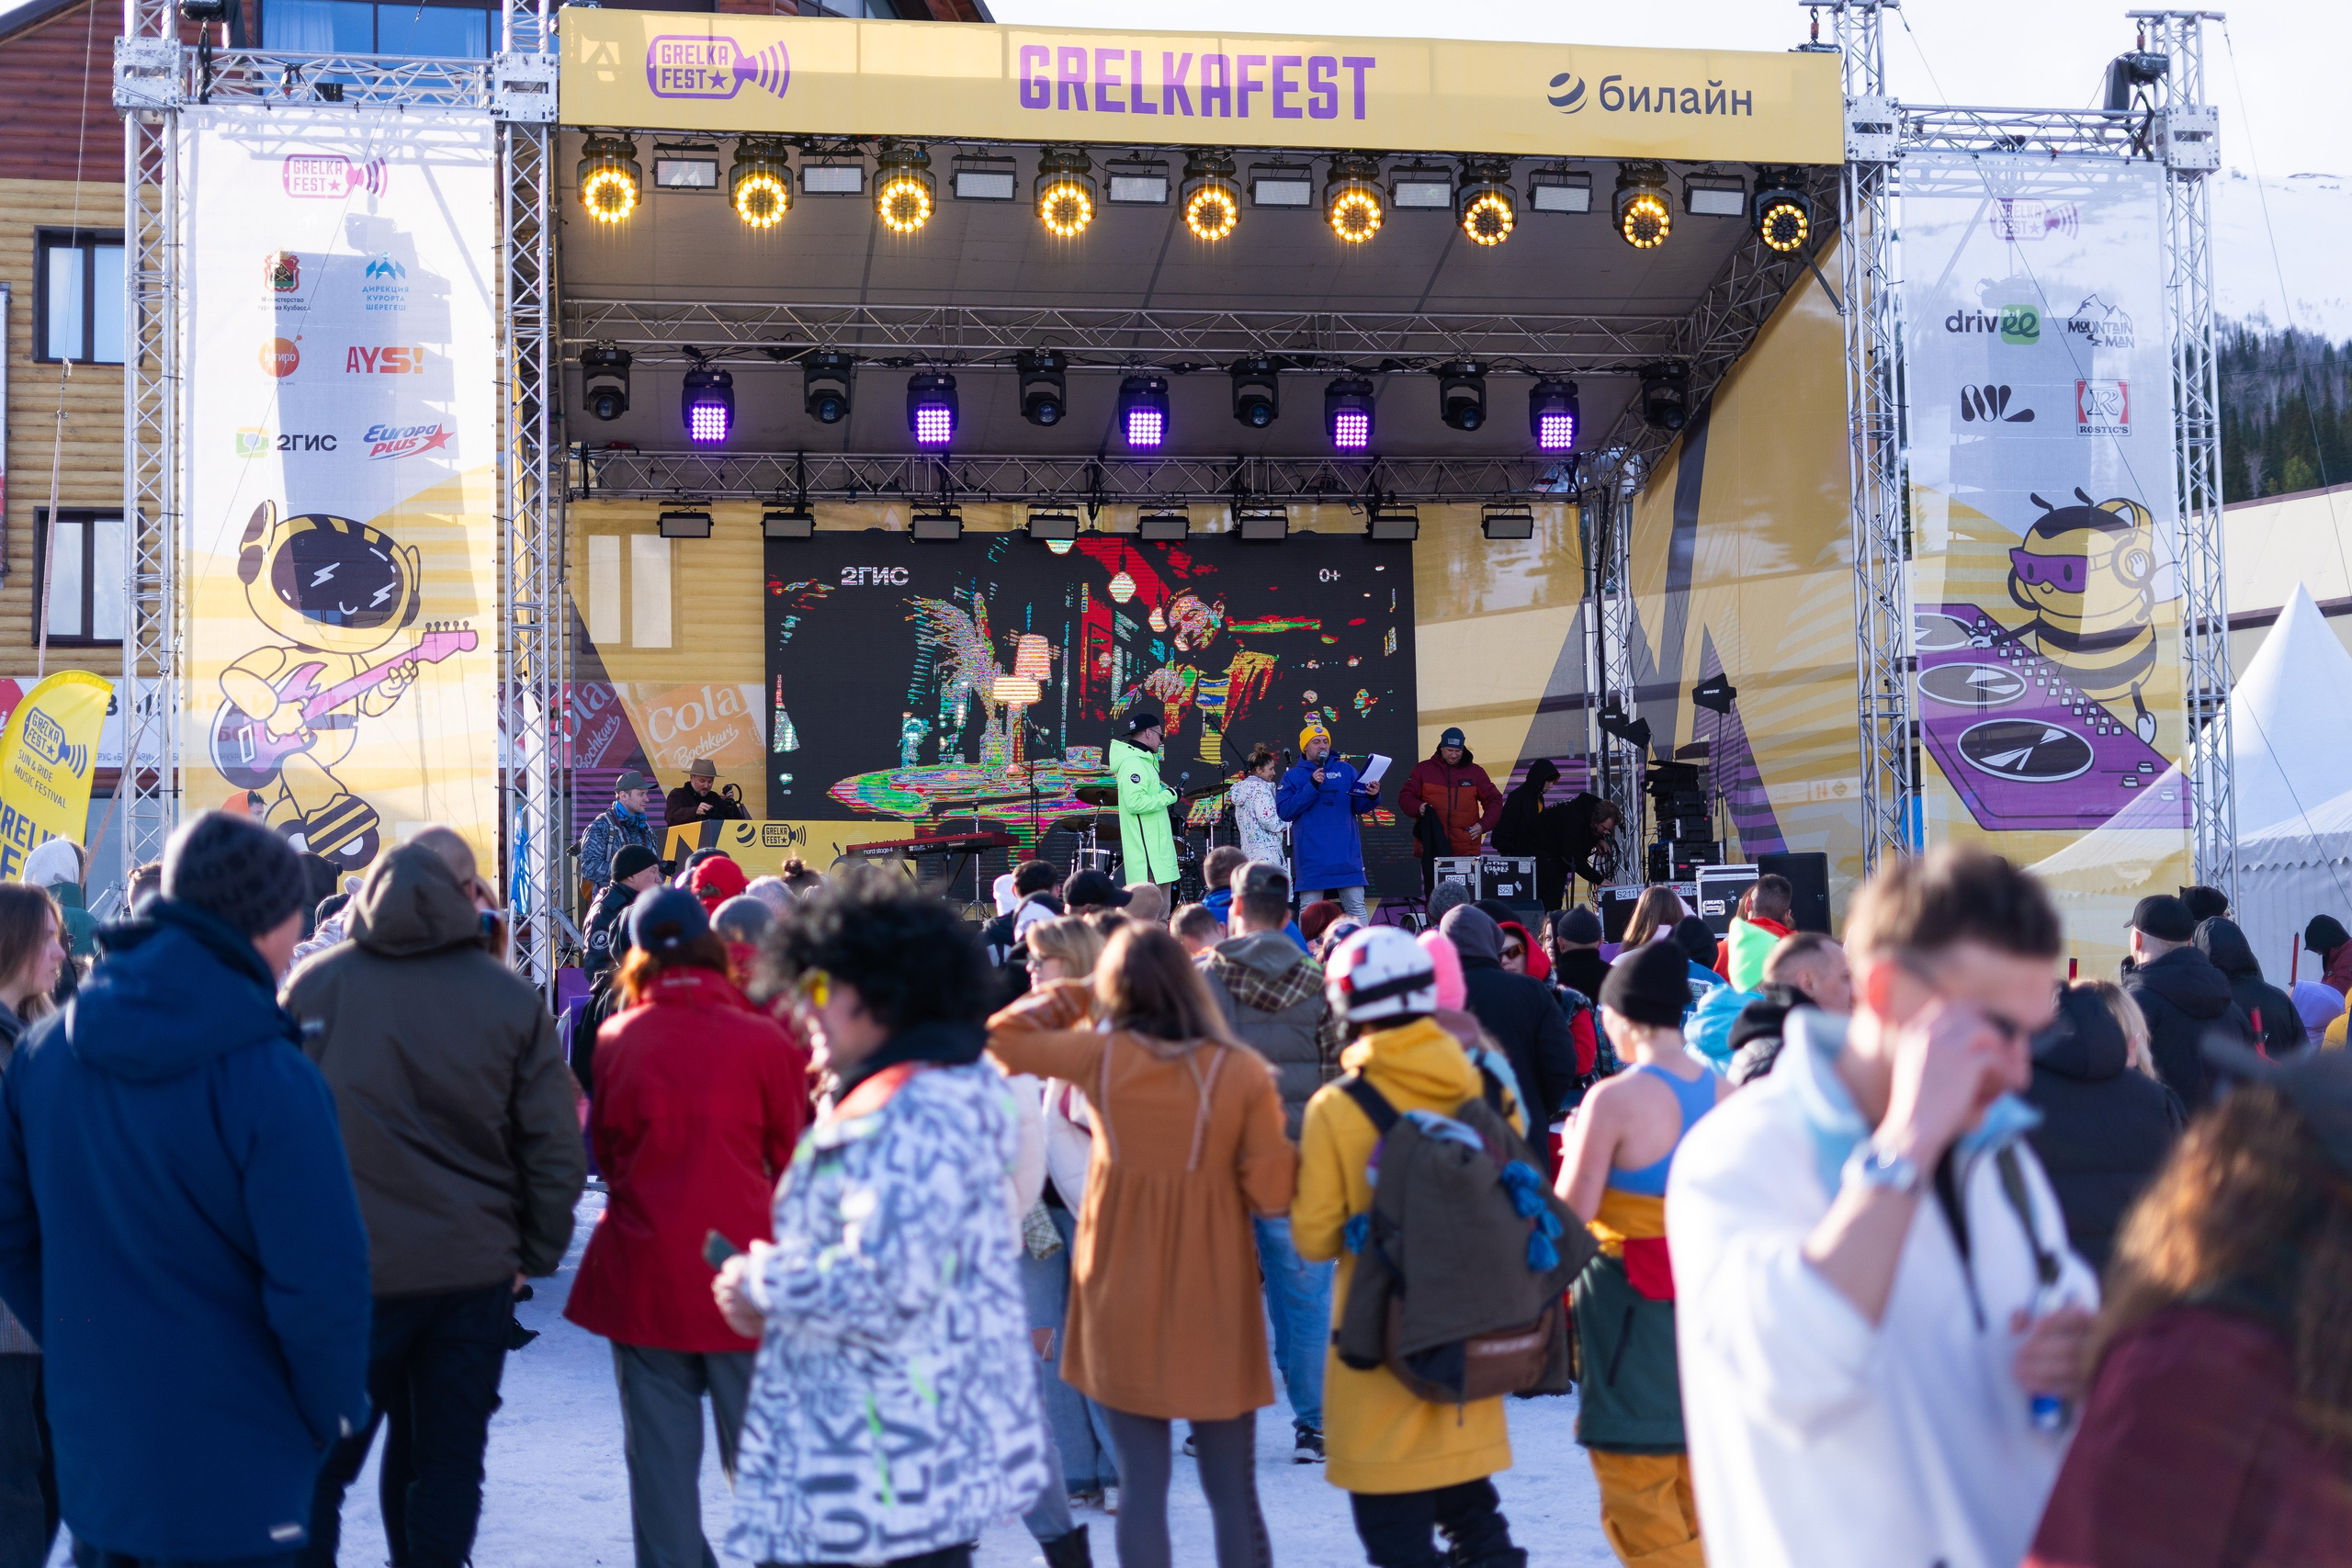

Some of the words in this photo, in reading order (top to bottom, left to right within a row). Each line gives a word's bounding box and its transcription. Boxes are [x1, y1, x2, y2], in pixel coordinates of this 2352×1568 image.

[662, 44, 729, 65] GRELKA
[662, 68, 707, 89] FEST
[1019, 44, 1376, 120] GRELKAFEST
[1599, 74, 1752, 116] билайн
[293, 160, 343, 175] GRELKA
[294, 177, 327, 192] FEST
[2000, 220, 2028, 233] FEST
[362, 286, 409, 294] ДИРЕКЦИЯ
[1945, 310, 2040, 337] drivee
[2067, 321, 2133, 334] MOUNTAIN
[2105, 335, 2134, 348] MAN
[345, 346, 424, 374] AYS!
[2079, 425, 2129, 434] ROSTIC'S
[277, 434, 337, 451] 2ГИС
[841, 567, 909, 586] 2ГИС
[1318, 568, 1341, 582] 0+
[649, 685, 741, 743] Cola
[32, 714, 60, 743] GRELKA
[27, 729, 47, 750] FEST
[673, 724, 736, 768] Bochkari
[17, 750, 31, 766] SUN
[31, 759, 36, 772] &
[37, 764, 53, 783] RIDE
[14, 764, 34, 787] MUSIC
[34, 782, 67, 808] FESTIVAL
[766, 828, 787, 836] GRELKA
[1498, 886, 1513, 895] S250
[1617, 890, 1635, 898] S211
